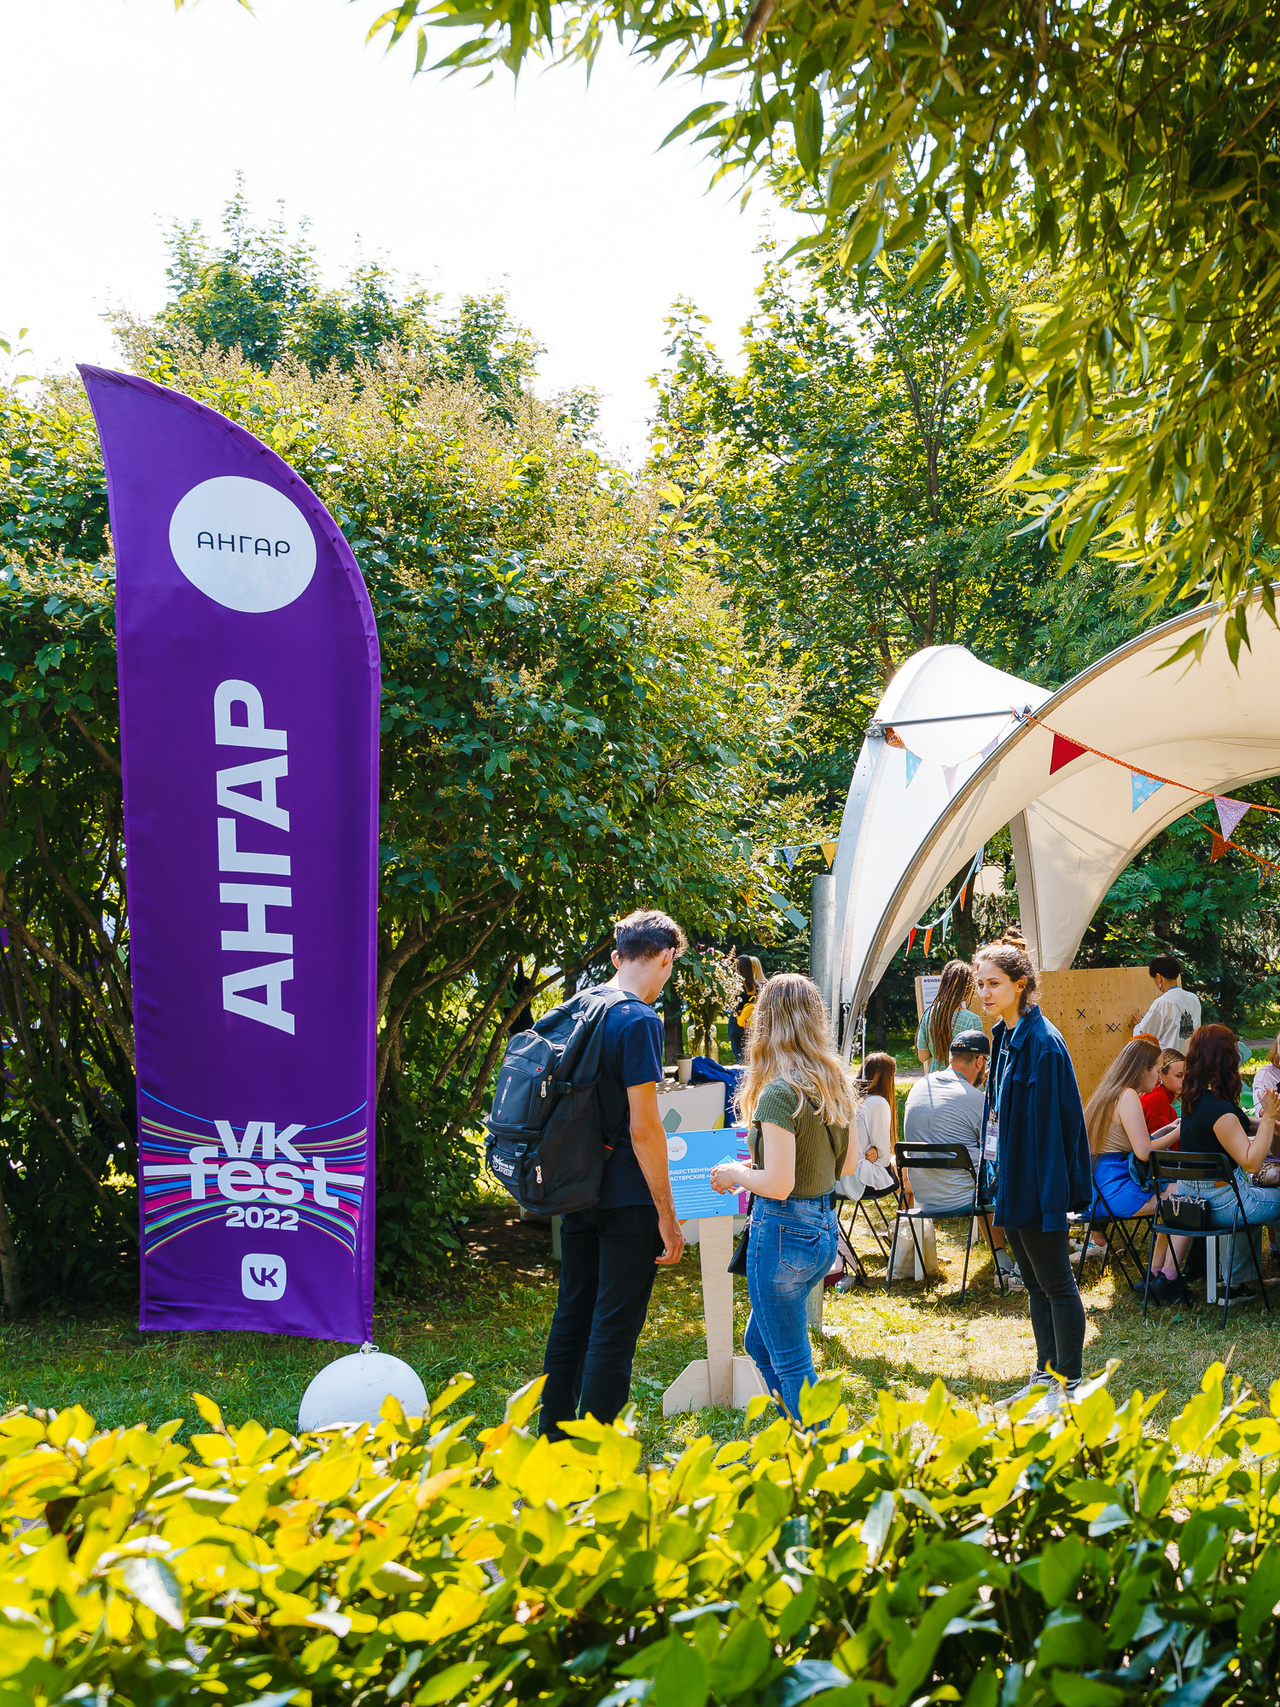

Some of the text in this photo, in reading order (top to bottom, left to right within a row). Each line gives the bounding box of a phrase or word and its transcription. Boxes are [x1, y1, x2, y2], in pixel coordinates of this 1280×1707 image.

[197, 531, 291, 557] АНГАР
[213, 679, 295, 1036] АНГАР
[214, 1120, 308, 1163] VK
[143, 1146, 365, 1209] fest
[668, 1167, 712, 1175] БЩЕСТВЕННЫ
[669, 1173, 706, 1181] АСТЕРСКИЕ
[225, 1206, 300, 1231] 2022
[249, 1266, 279, 1288] VK
